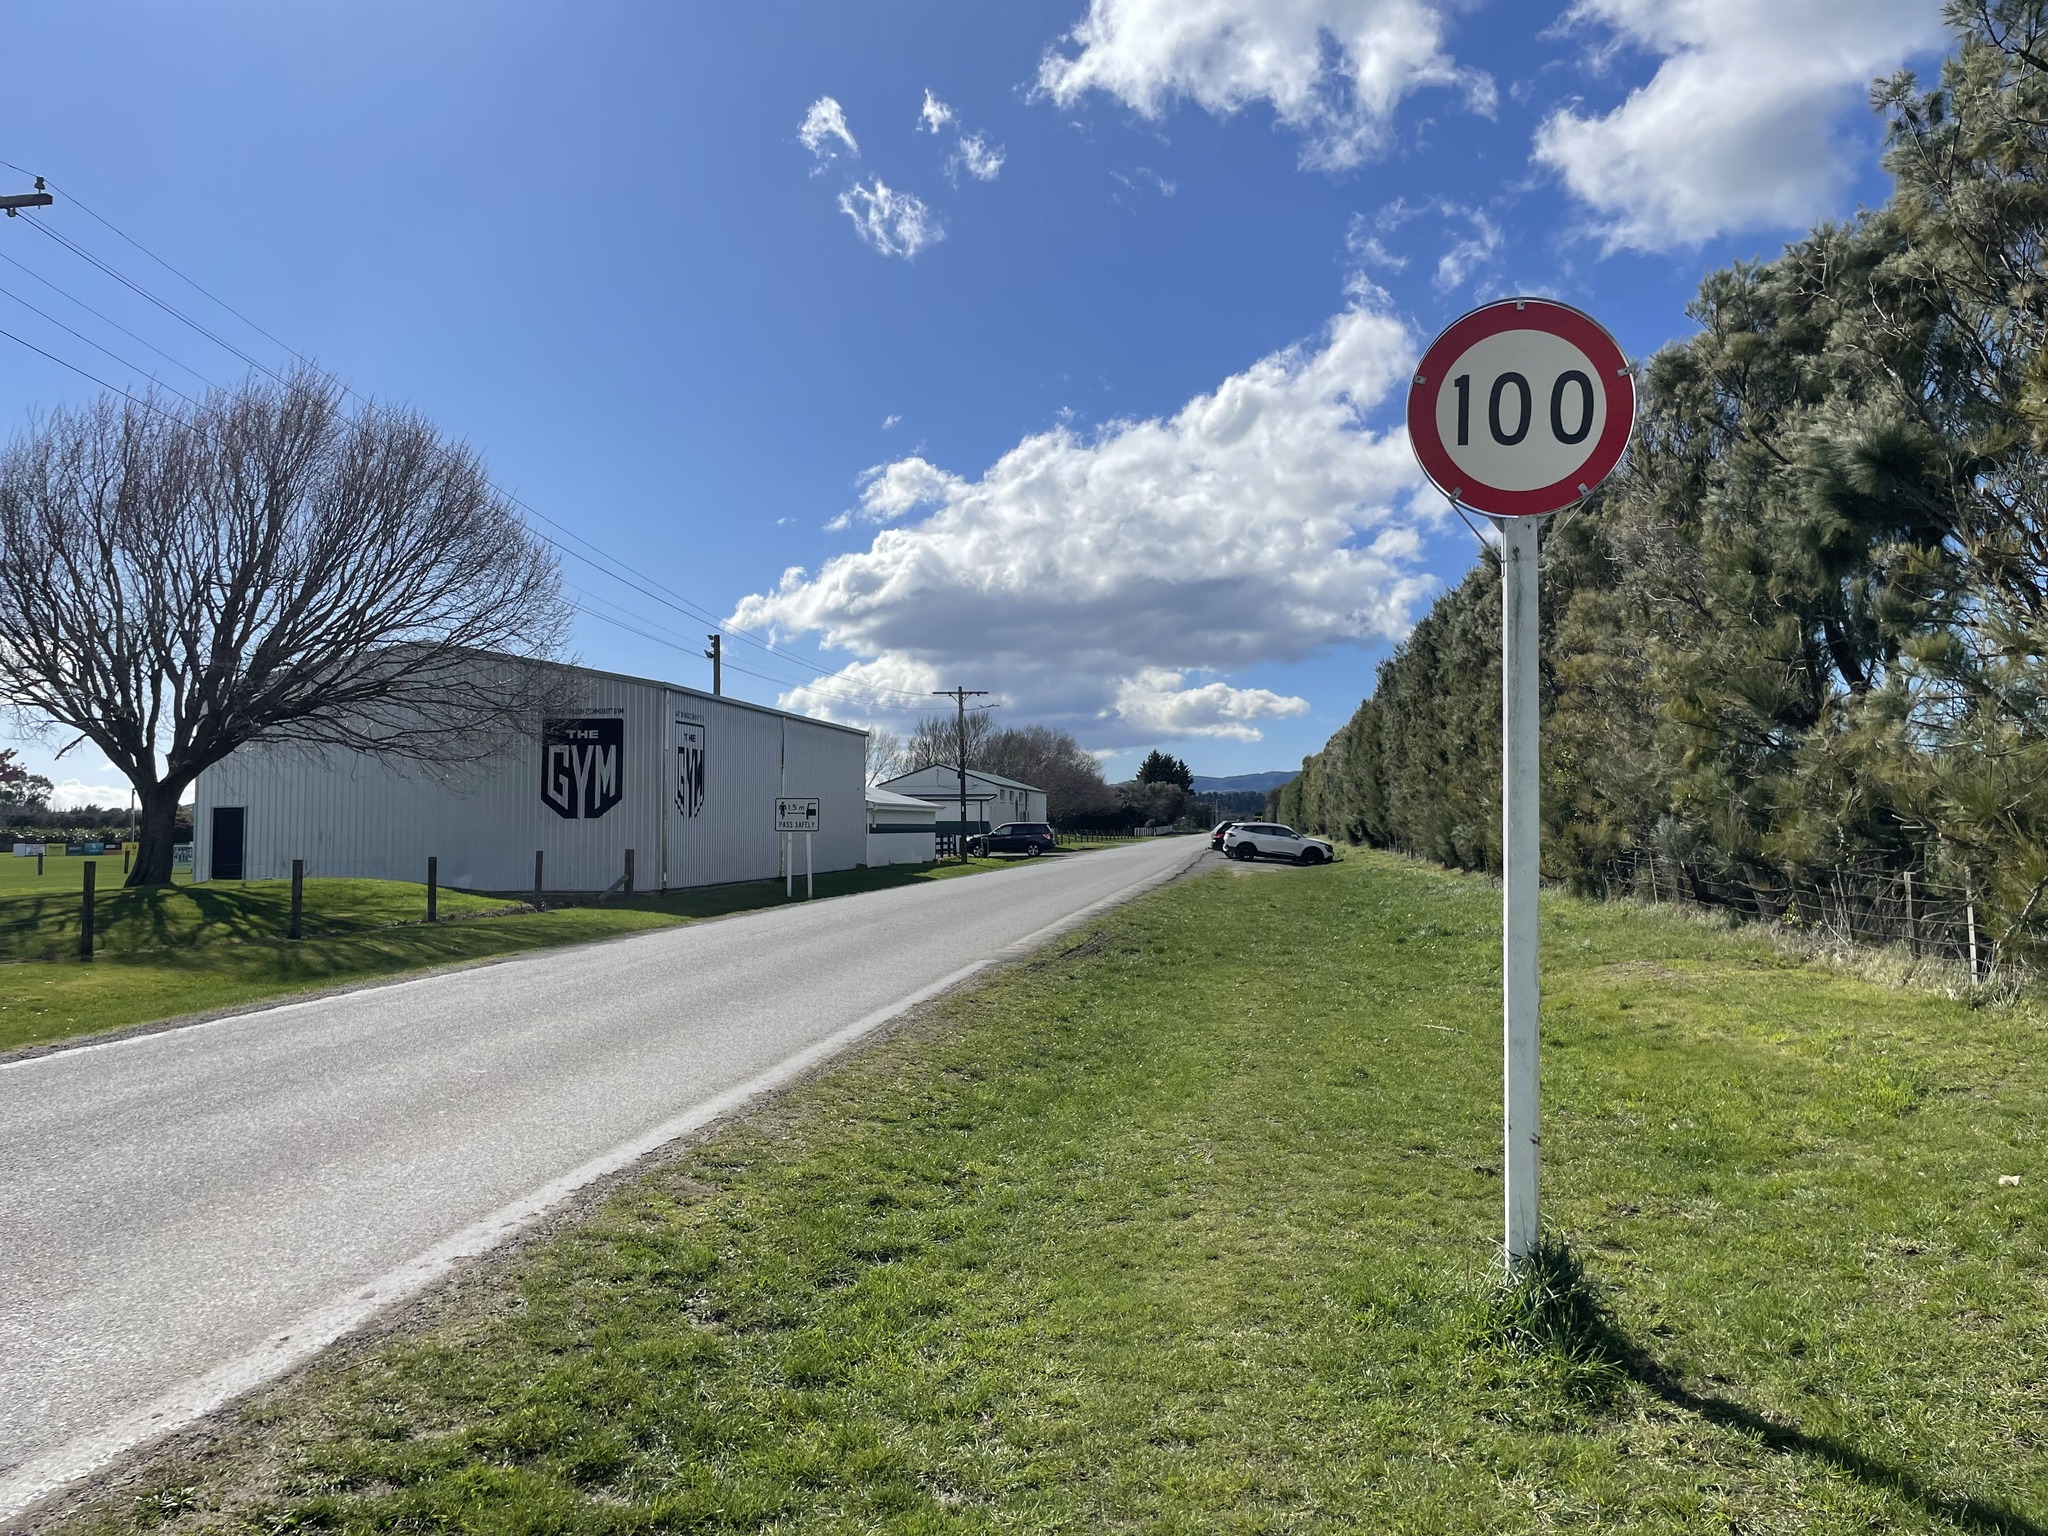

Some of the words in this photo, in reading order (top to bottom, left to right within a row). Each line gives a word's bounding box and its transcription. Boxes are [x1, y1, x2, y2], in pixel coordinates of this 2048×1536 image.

[1454, 370, 1595, 446] 100
[566, 729, 599, 739] THE
[684, 733, 696, 743] THE
[547, 744, 617, 819] GYM
[677, 746, 703, 818] GYM
[794, 821, 816, 829] SAFELY
